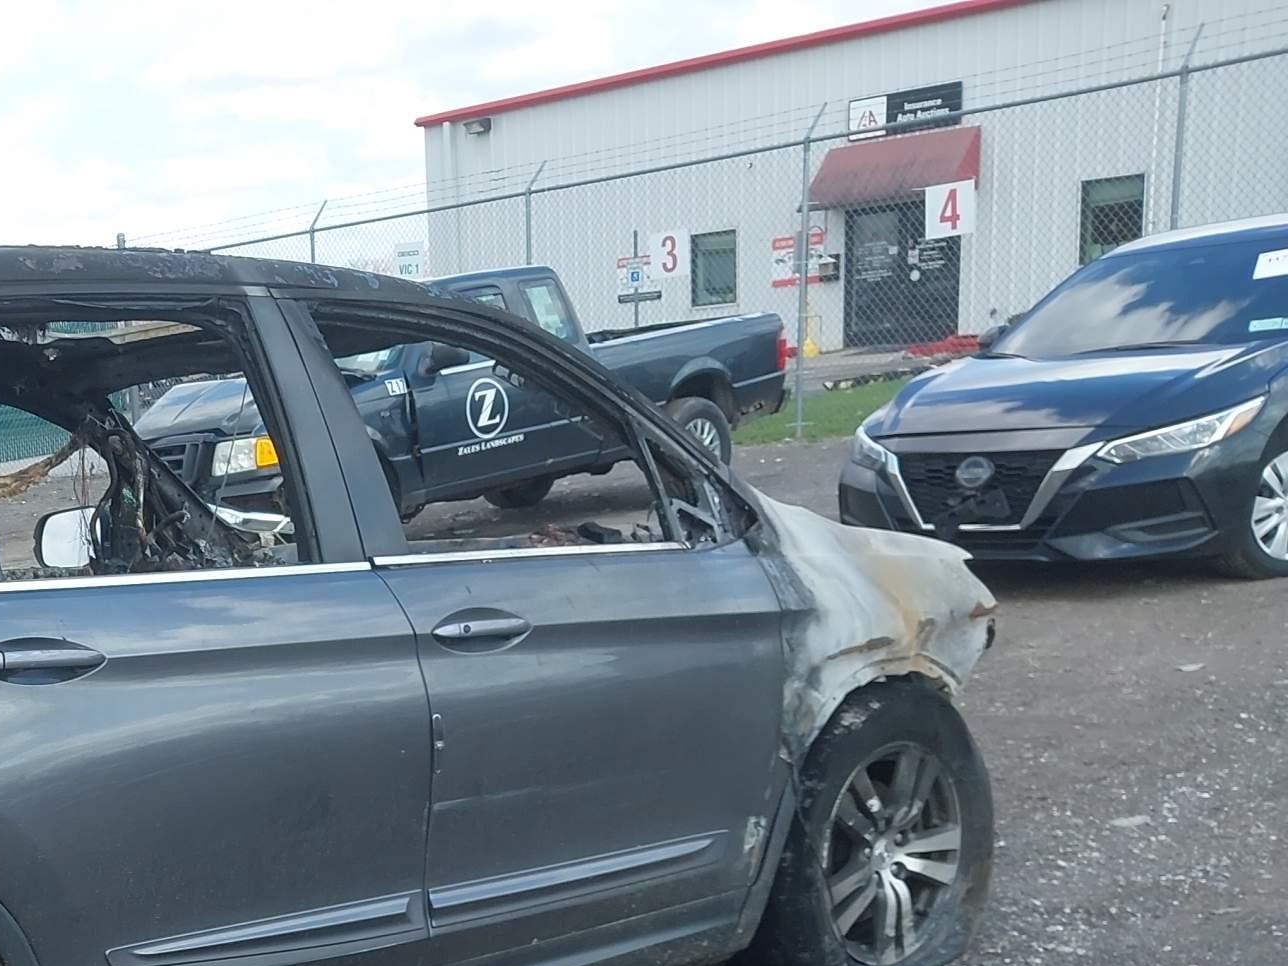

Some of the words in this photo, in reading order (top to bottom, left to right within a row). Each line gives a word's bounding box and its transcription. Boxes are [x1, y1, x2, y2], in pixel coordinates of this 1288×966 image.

[939, 188, 961, 230] 4
[398, 263, 413, 275] VIC
[661, 235, 678, 273] 3
[474, 388, 501, 428] Z
